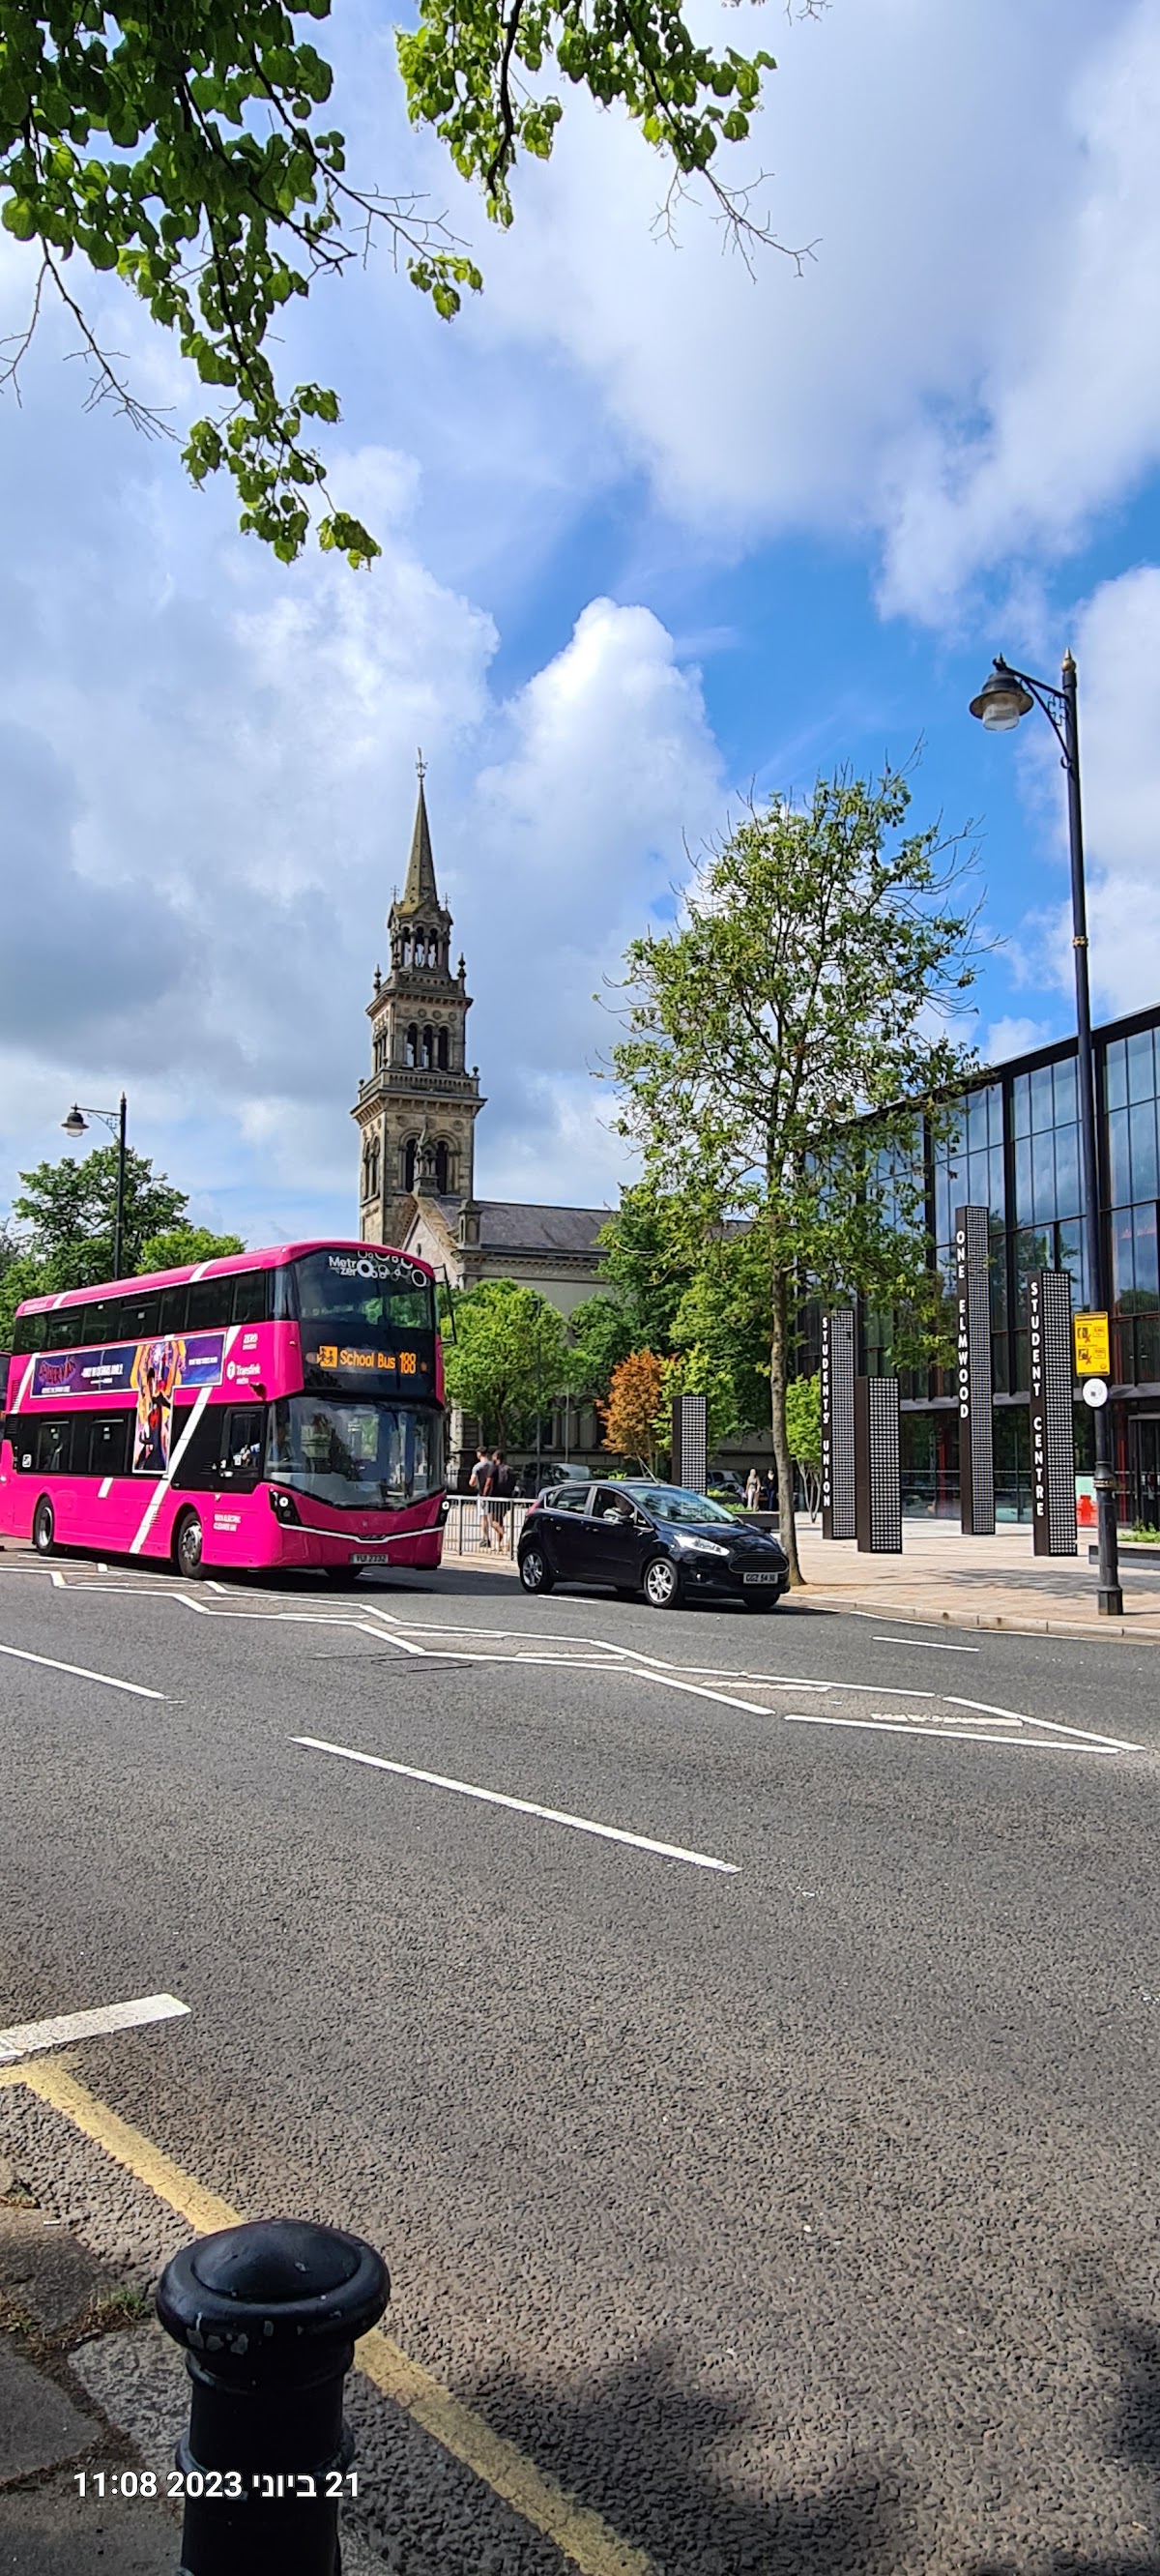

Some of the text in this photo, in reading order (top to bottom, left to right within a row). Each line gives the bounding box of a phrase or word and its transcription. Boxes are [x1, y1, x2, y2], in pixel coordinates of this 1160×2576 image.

[339, 1350, 417, 1374] School Bus 188
[956, 1230, 970, 1419] ONE ELMWOOD
[1030, 1281, 1045, 1517] STUDENT CENTRE
[823, 1440, 831, 1508] UNION
